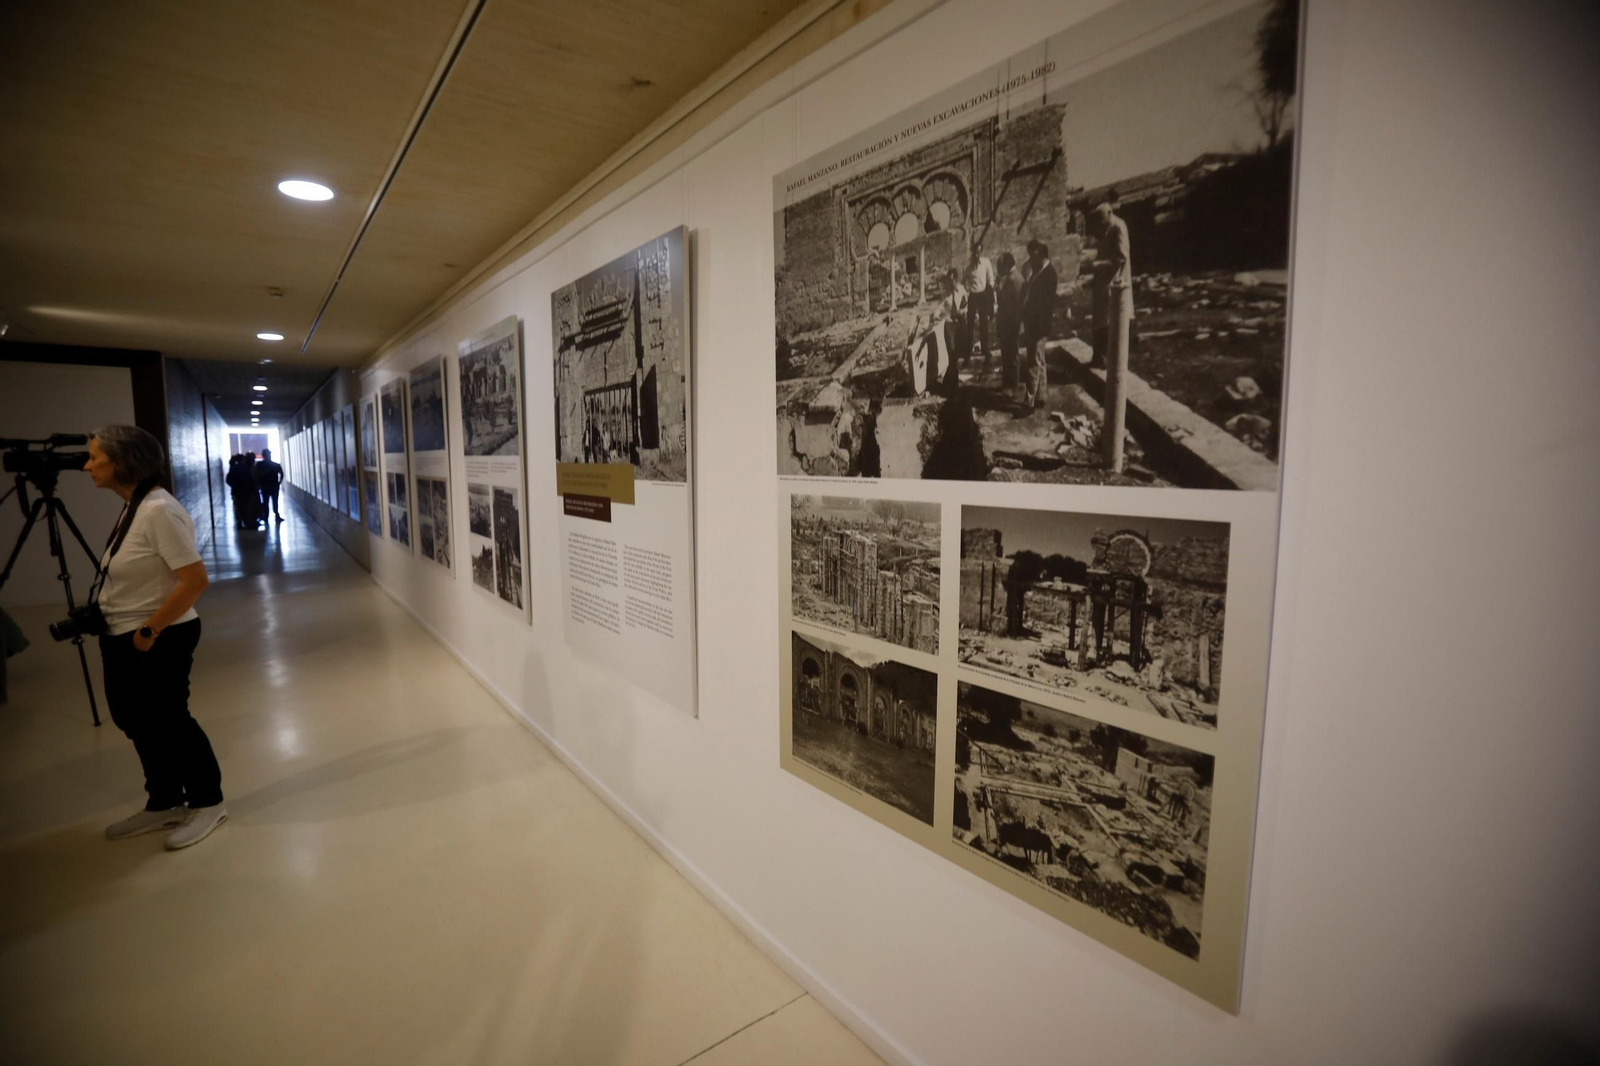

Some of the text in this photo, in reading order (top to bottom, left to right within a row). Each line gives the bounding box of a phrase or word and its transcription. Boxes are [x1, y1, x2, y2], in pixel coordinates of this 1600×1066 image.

[786, 177, 808, 193] RAFAEL
[894, 132, 900, 143] Y
[901, 118, 931, 139] NUEVAS
[933, 86, 1000, 125] EXCAVACIONES
